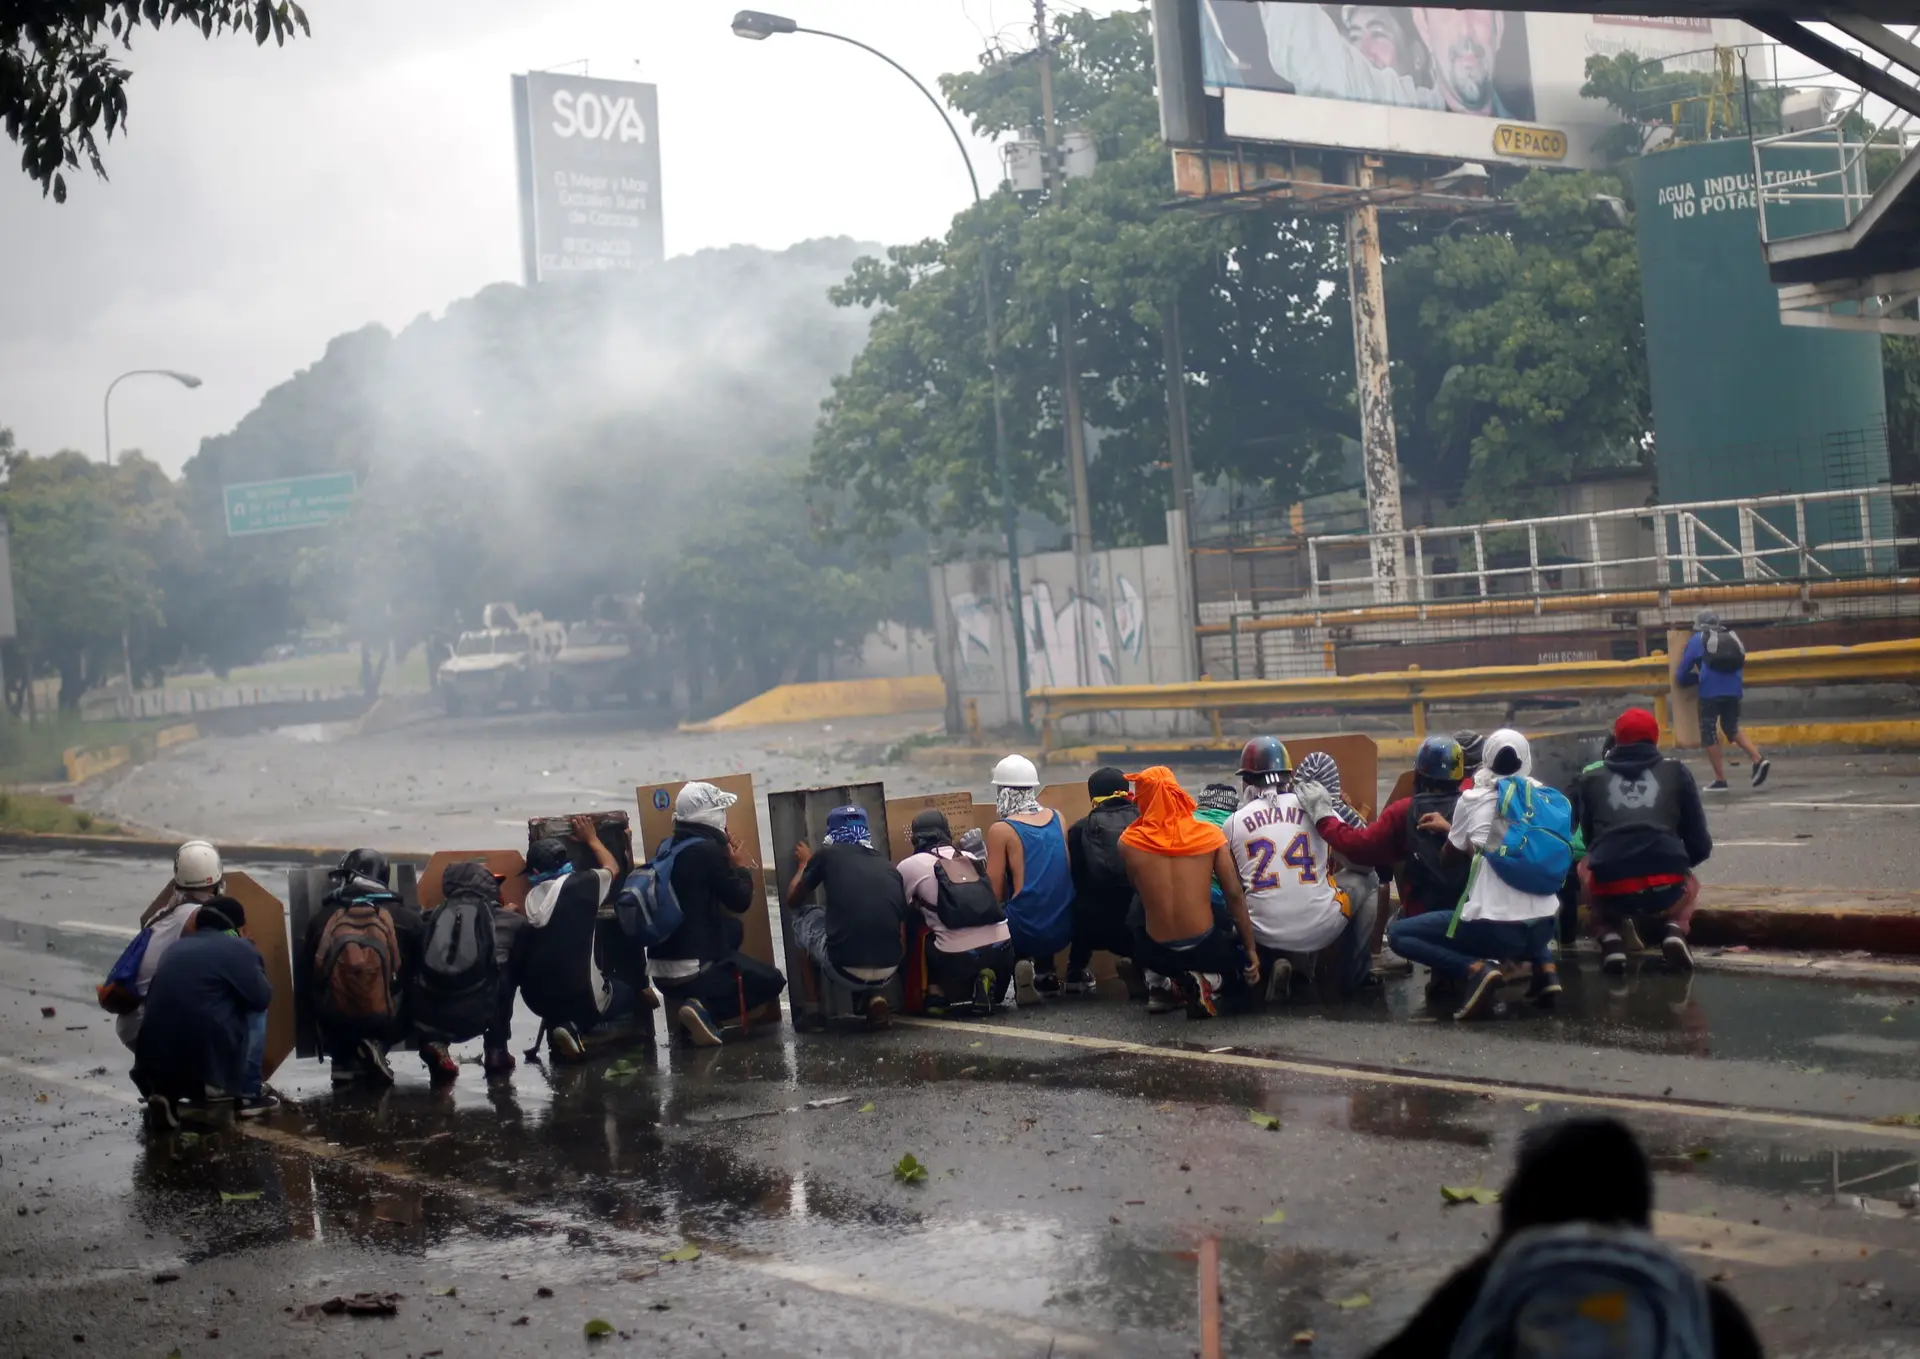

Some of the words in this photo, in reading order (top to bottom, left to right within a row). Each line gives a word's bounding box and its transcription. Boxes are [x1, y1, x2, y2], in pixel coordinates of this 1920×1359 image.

[552, 89, 645, 143] SOYA
[1501, 128, 1560, 153] VEPACO
[1658, 182, 1696, 206] AGUA
[1672, 202, 1696, 220] NO
[1242, 805, 1306, 834] BRYANT
[1245, 831, 1318, 892] 24
